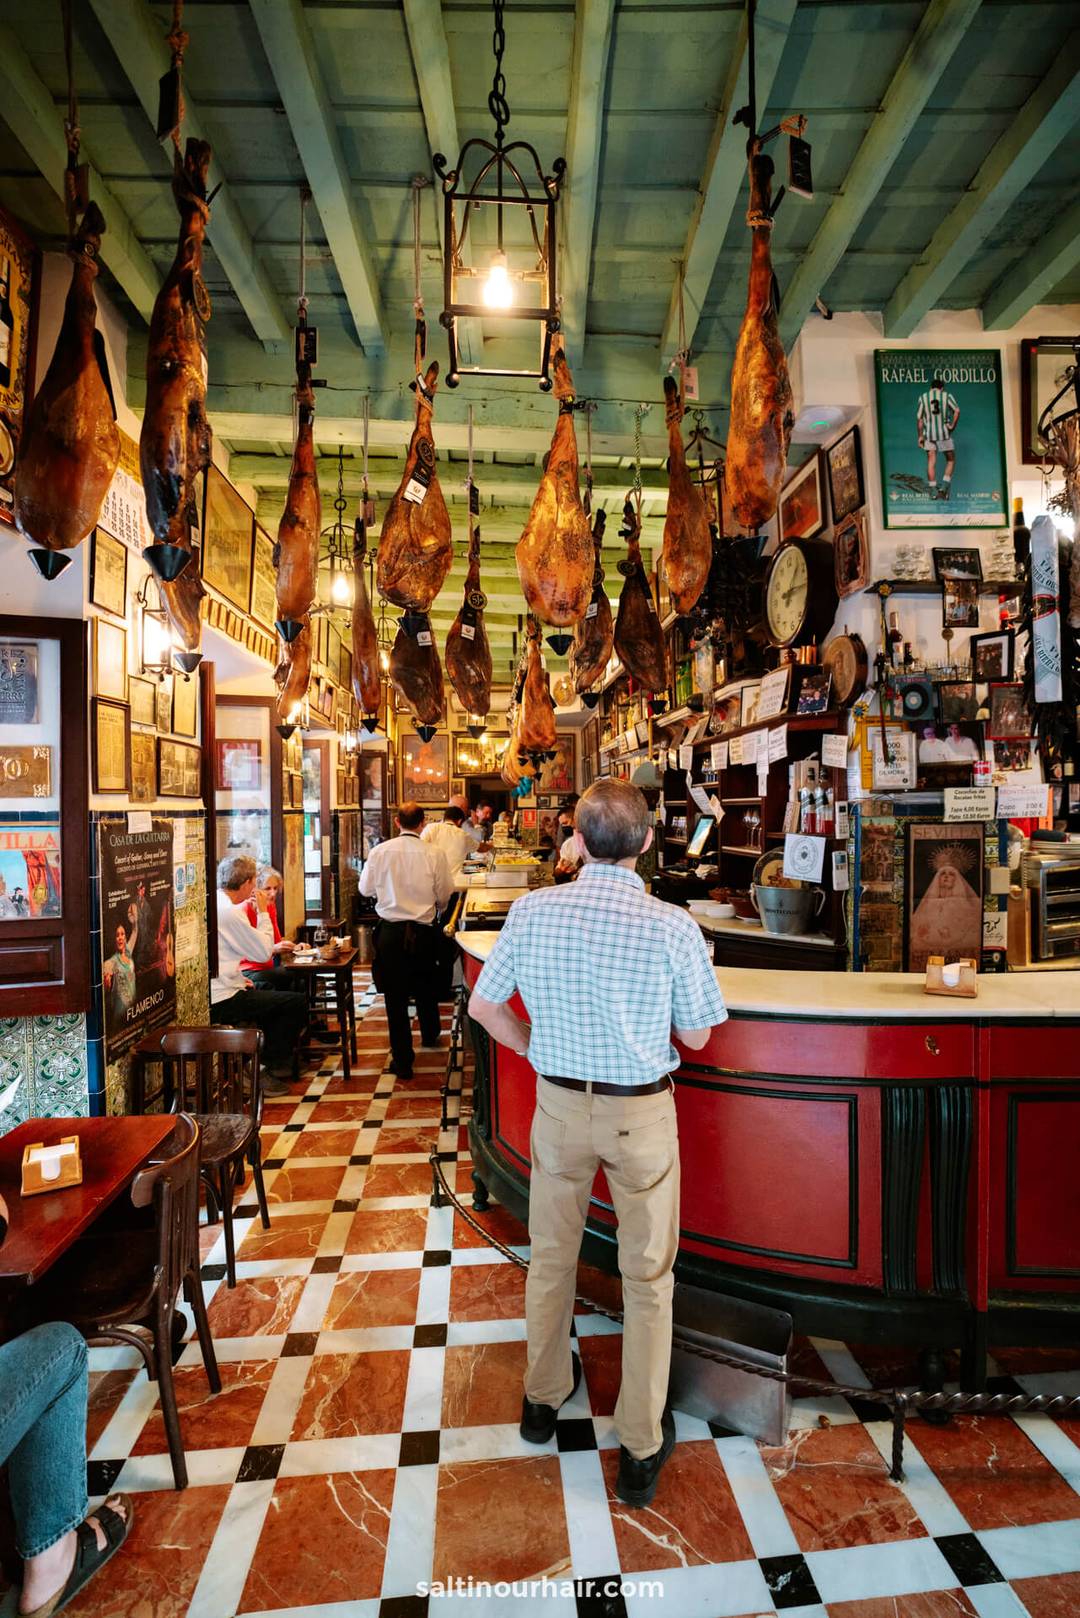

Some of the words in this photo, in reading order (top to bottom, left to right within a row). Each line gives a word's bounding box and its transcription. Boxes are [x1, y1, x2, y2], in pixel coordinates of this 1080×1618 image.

[882, 368, 928, 383] RAFAEL
[934, 368, 996, 383] GORDILLO
[931, 399, 940, 415] 3
[913, 826, 980, 838] SEVILLA
[126, 989, 165, 1021] FLAMENCO
